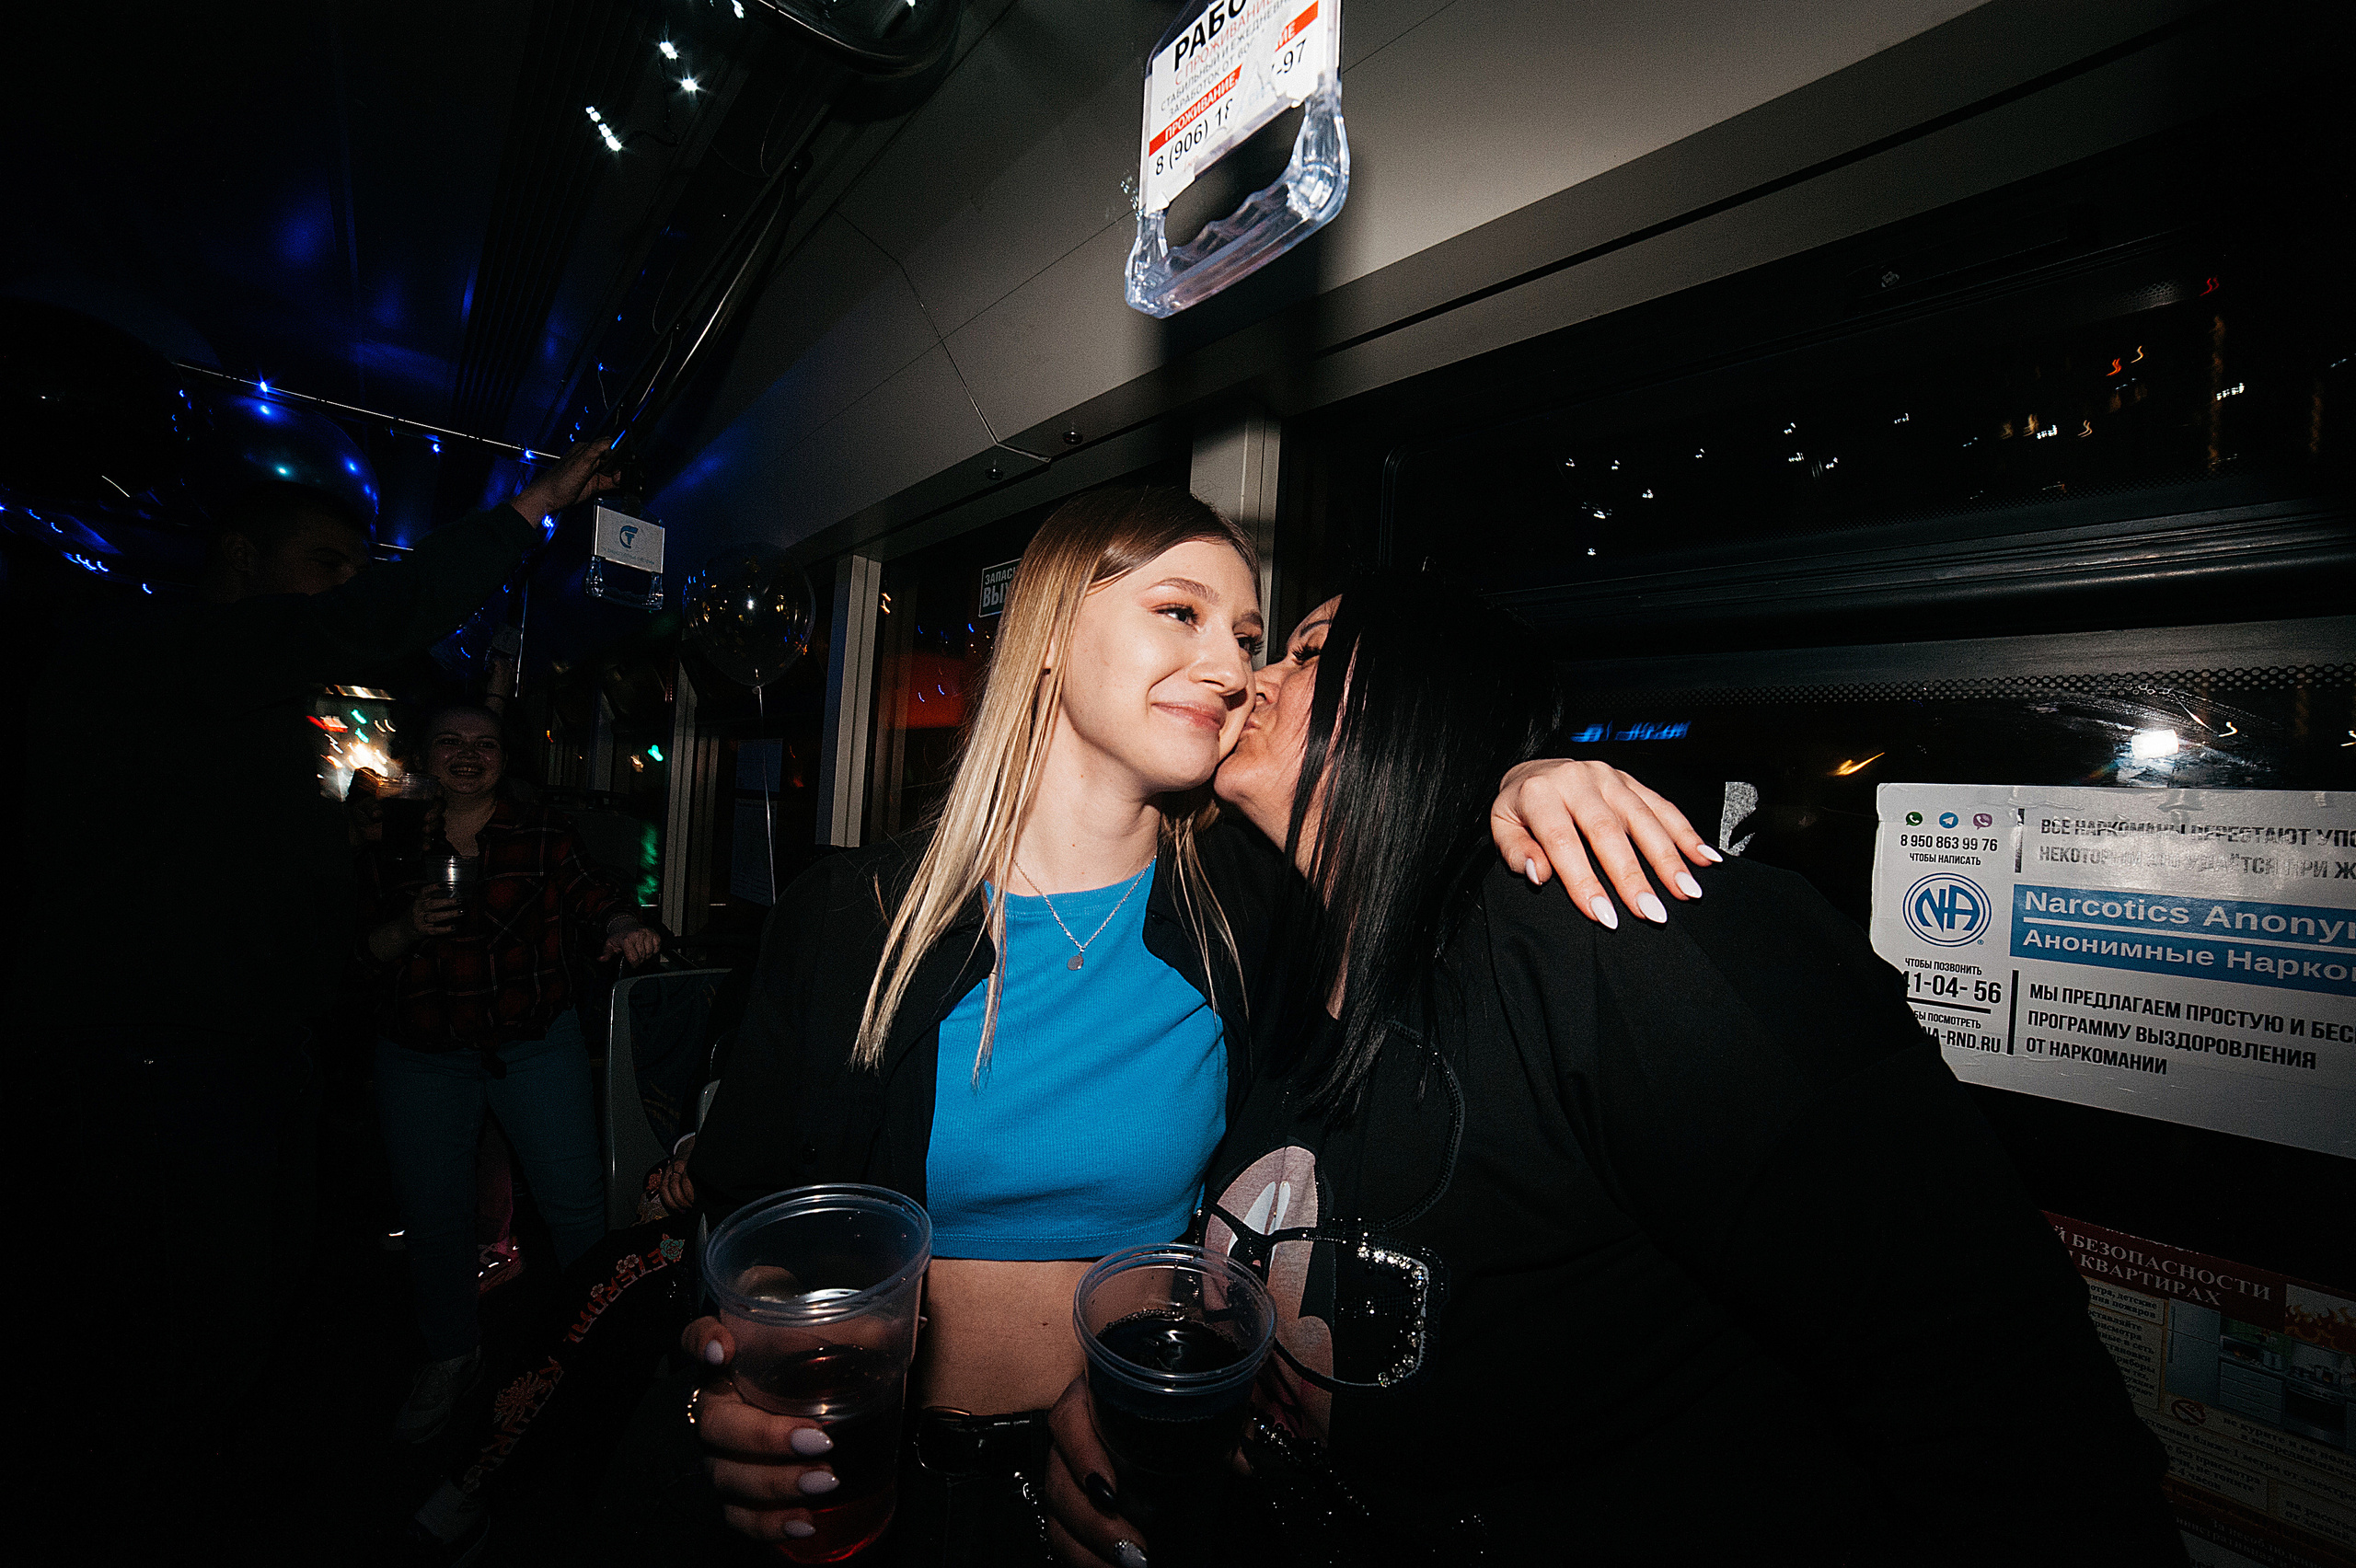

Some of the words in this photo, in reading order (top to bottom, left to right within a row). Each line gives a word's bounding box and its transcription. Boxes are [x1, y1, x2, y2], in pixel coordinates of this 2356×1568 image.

[1185, 0, 1272, 77] ПРОЖИВАНИ
[1155, 155, 1164, 176] 8
[1169, 119, 1208, 169] (906)
[1271, 38, 1306, 74] -97
[1163, 72, 1237, 142] ПРОЖИВАНИЕ
[1900, 834, 1909, 847] 8
[1911, 835, 1934, 848] 950
[1935, 836, 1959, 849] 863
[1962, 836, 1979, 851] 99
[1981, 838, 1998, 852] 76
[2040, 818, 2071, 835] ВСЕ
[2190, 824, 2312, 847] ПЕРЕСТАЮТ
[1909, 852, 1937, 863] ЧТОБЫ
[1938, 854, 1981, 866] НАПИСАТЬ
[2025, 890, 2190, 925] Narcotics
[1905, 957, 1932, 970] ЧТОБЫ
[1934, 961, 1982, 975] ПОЗВОНИТЬ
[2022, 928, 2215, 967] Анонимные
[2226, 950, 2356, 982] Нарко
[1973, 979, 2002, 1004] 56
[1927, 1013, 1981, 1030] ПОСМОТРЕТЬ
[2029, 983, 2059, 1002] МЫ
[2062, 986, 2182, 1020] ПРЕДЛАГАЕМ
[2185, 1004, 2285, 1034] ПРОСТУЮ
[2289, 1019, 2305, 1037] И
[2310, 1020, 2356, 1044] БЕС
[2025, 1036, 2047, 1055] ОТ
[2049, 1042, 2168, 1076] НАРКОМАНИИ
[2027, 1009, 2132, 1041] ПРОГРАММУ
[2134, 1025, 2317, 1071] ВЫЗДОРОВЛЕНИЯ
[2072, 1233, 2272, 1302] БЕЗОПАСНОСТИ
[2079, 1254, 2223, 1308] КВАРТИРАХ
[2319, 1451, 2355, 1469] поль
